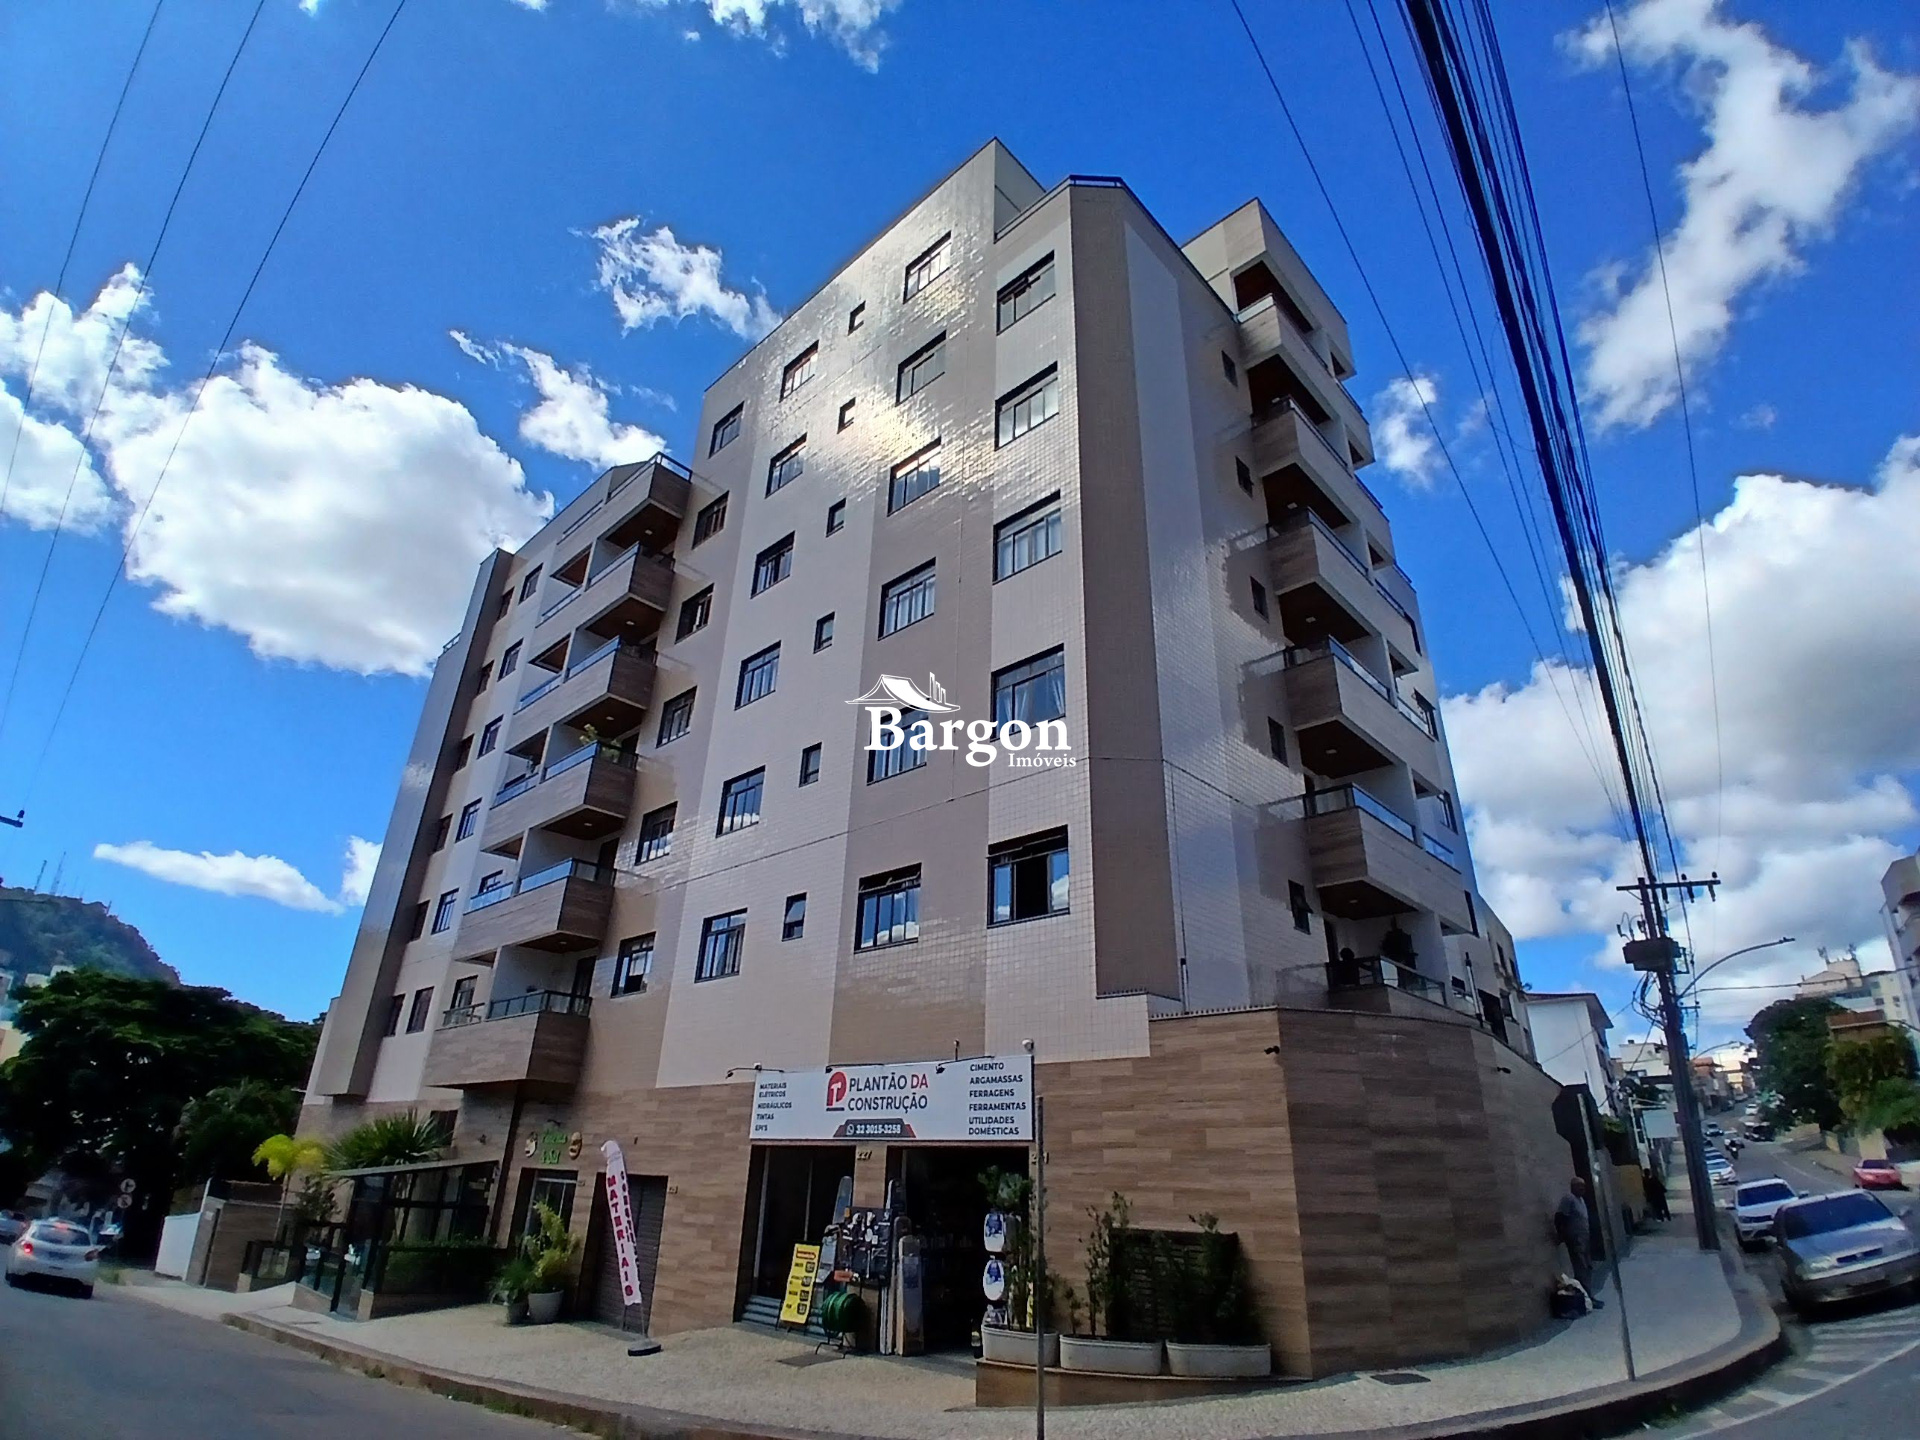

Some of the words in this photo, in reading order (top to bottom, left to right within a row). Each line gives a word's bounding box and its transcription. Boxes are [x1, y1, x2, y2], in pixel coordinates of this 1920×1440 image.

[970, 1062, 1005, 1071] CIMENTO
[849, 1072, 908, 1092] PLANTÃO
[911, 1073, 929, 1089] DA
[969, 1075, 1023, 1085] ARGAMASSAS
[969, 1089, 1015, 1098] FERRAGENS
[848, 1092, 928, 1114] CONSTRUÇÃO
[968, 1102, 1027, 1111] FERRAMENTAS
[968, 1116, 1015, 1125] UTILIDADES
[968, 1125, 1020, 1136] DOMÉSTICAS
